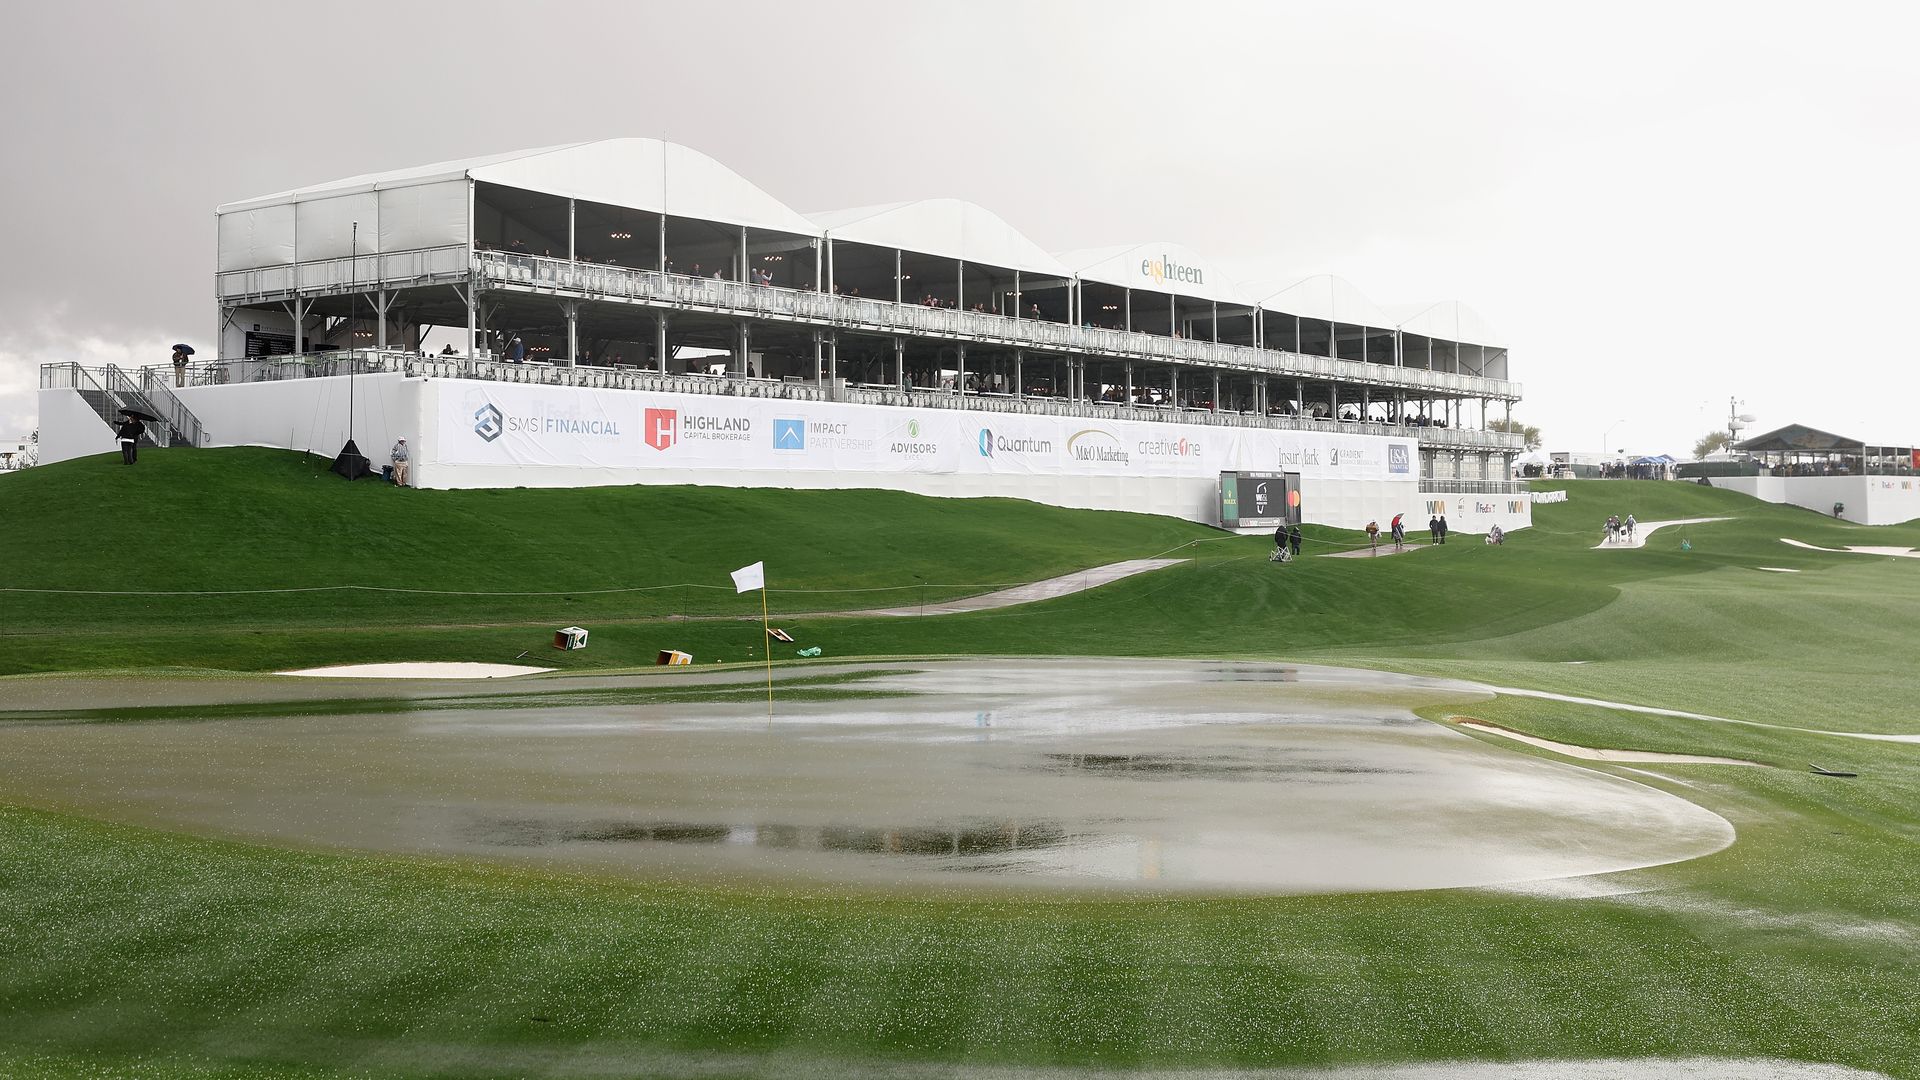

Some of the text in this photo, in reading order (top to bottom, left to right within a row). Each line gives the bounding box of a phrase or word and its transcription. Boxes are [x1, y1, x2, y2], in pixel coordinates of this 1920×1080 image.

[508, 417, 620, 435] SMS FINANCIAL
[683, 415, 751, 431] HIGHLAND
[810, 422, 848, 435] IMPACT
[683, 431, 751, 441] CAPITAL BROKERAGE
[809, 437, 873, 451] PARTNERSHIP
[890, 443, 937, 454] ADVISORS
[997, 436, 1052, 453] Quantum
[1076, 445, 1129, 466] M&O Marketing
[1390, 448, 1408, 464] USA
[1426, 501, 1446, 514] WM
[1508, 501, 1524, 513] WM
